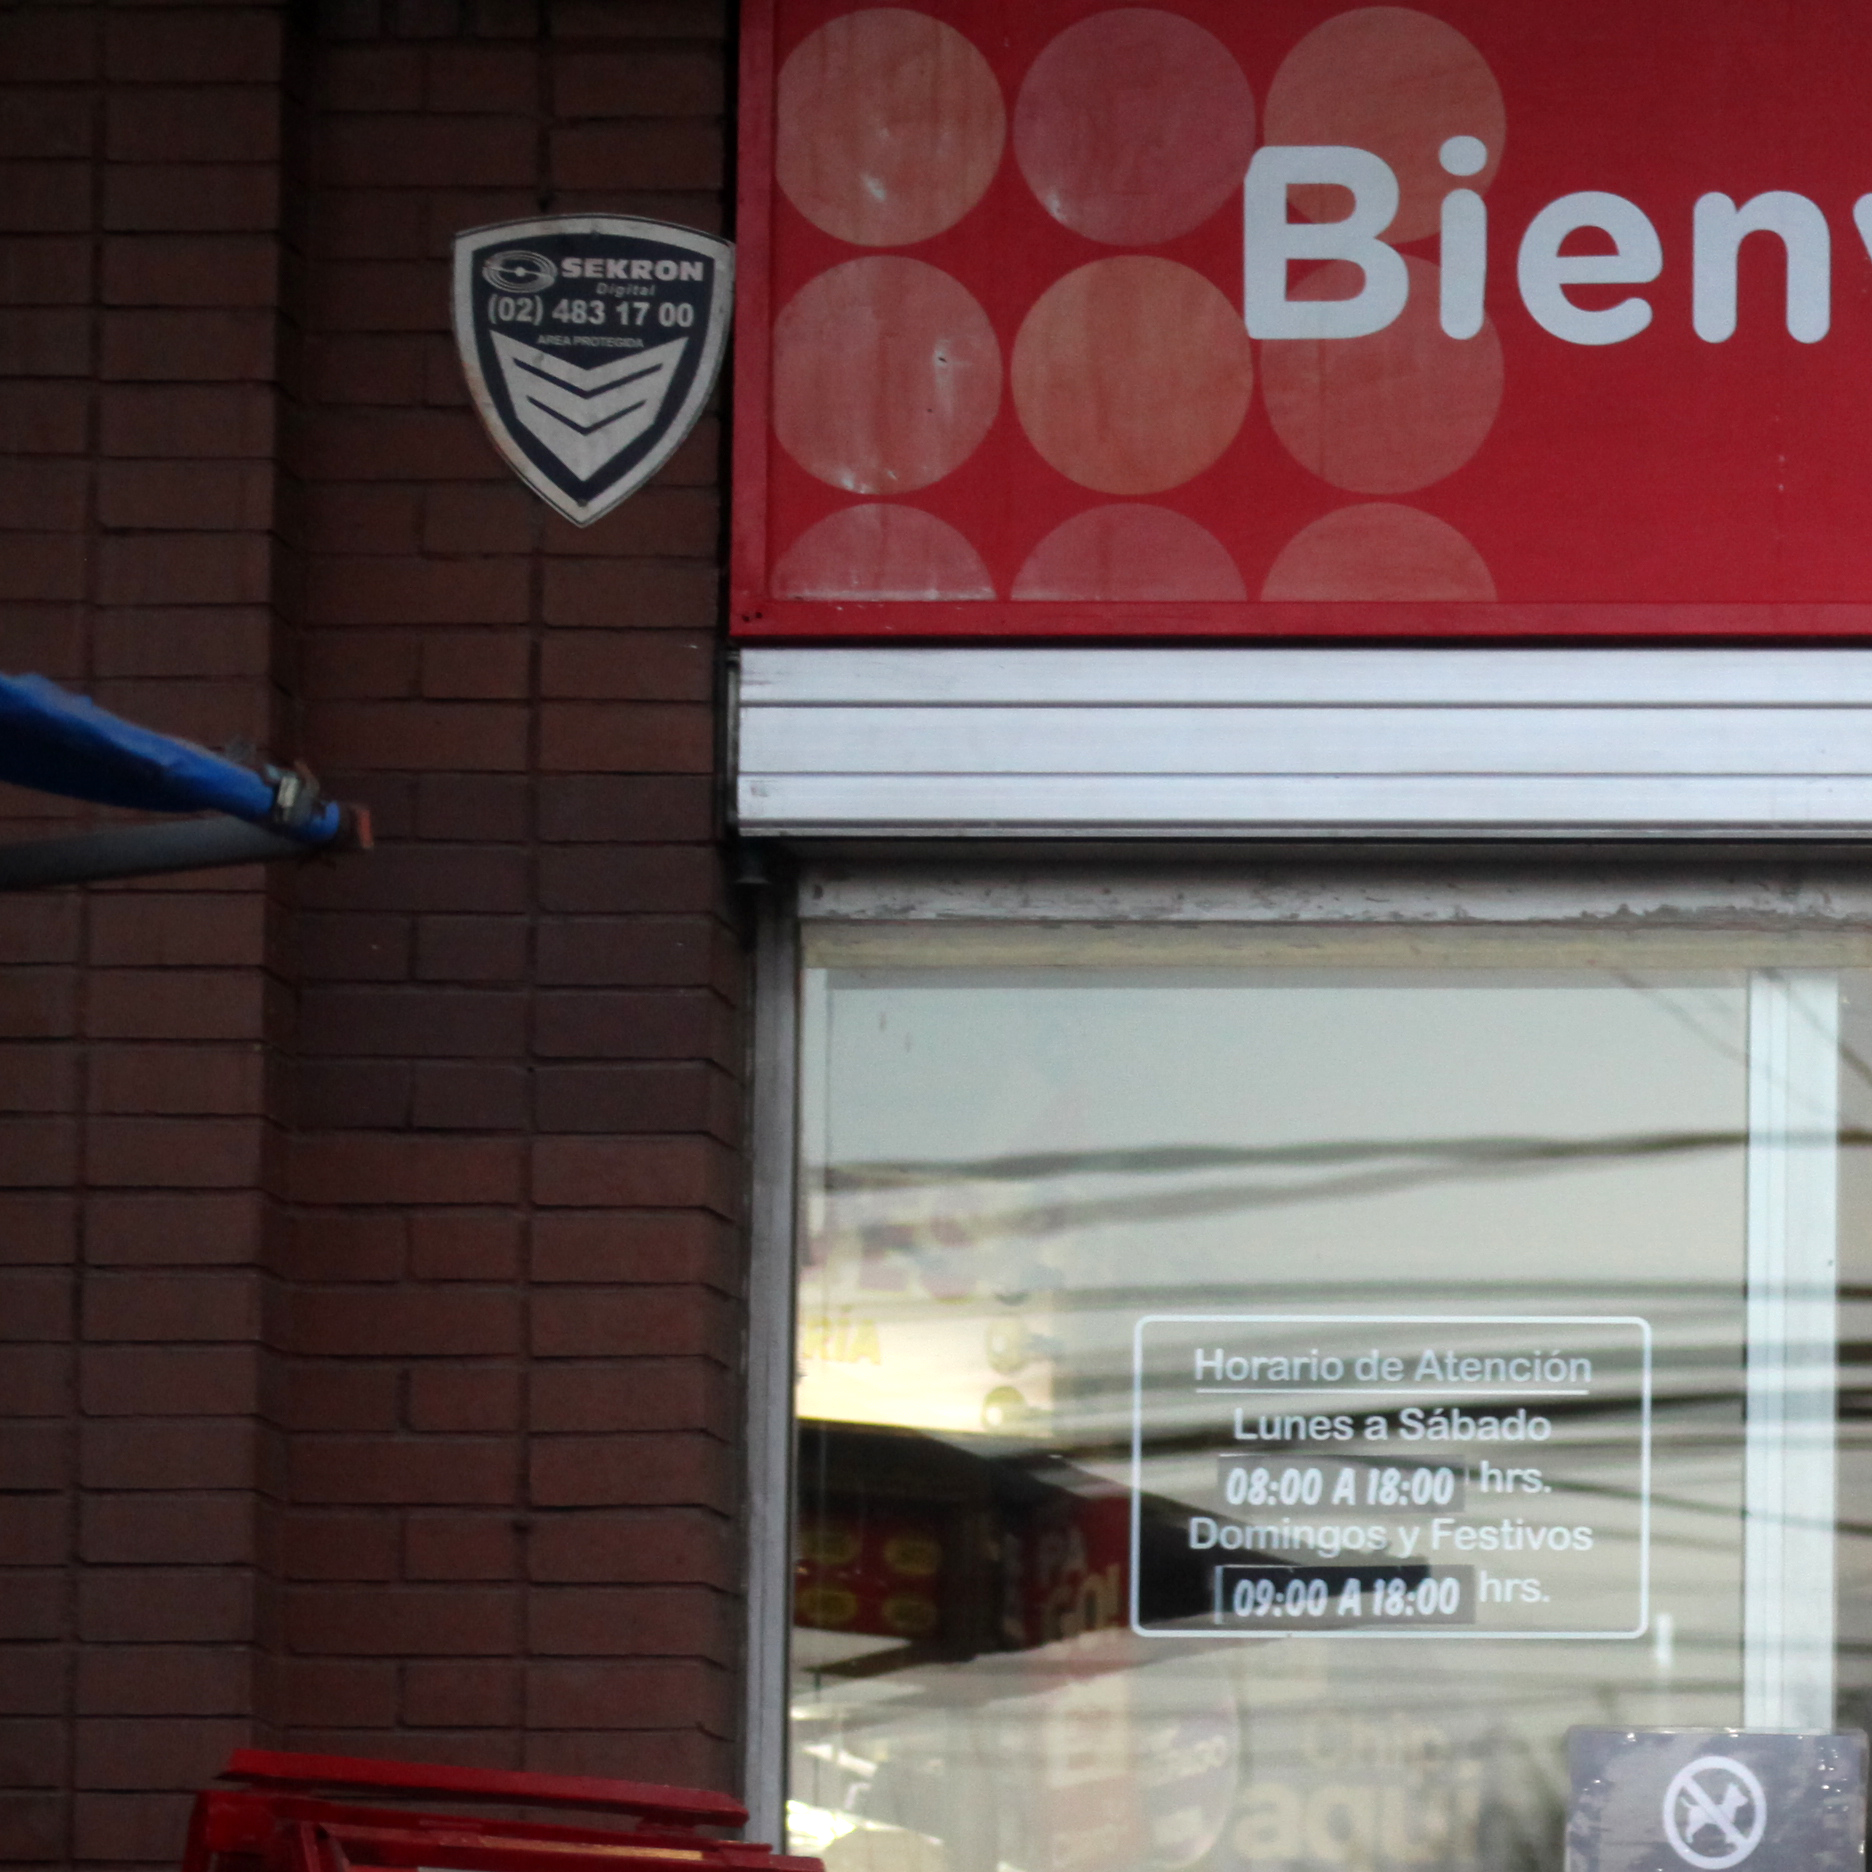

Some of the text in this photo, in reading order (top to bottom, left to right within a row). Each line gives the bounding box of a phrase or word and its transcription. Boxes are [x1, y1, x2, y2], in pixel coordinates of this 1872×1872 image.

[561, 258, 704, 282] SEKRON
[595, 281, 656, 297] Digital
[488, 294, 694, 328] (02) 483 17 00
[573, 335, 645, 349] PROTEGIDA
[1194, 1348, 1592, 1384] Horario de Atención
[1234, 1407, 1552, 1442] Lunes a Sábado
[1226, 1460, 1552, 1506] 08:00 A 18:00 hrs.
[1189, 1518, 1593, 1558] Domingos y Festivos
[1233, 1571, 1550, 1617] 09:00 A 18:00 hrs.
